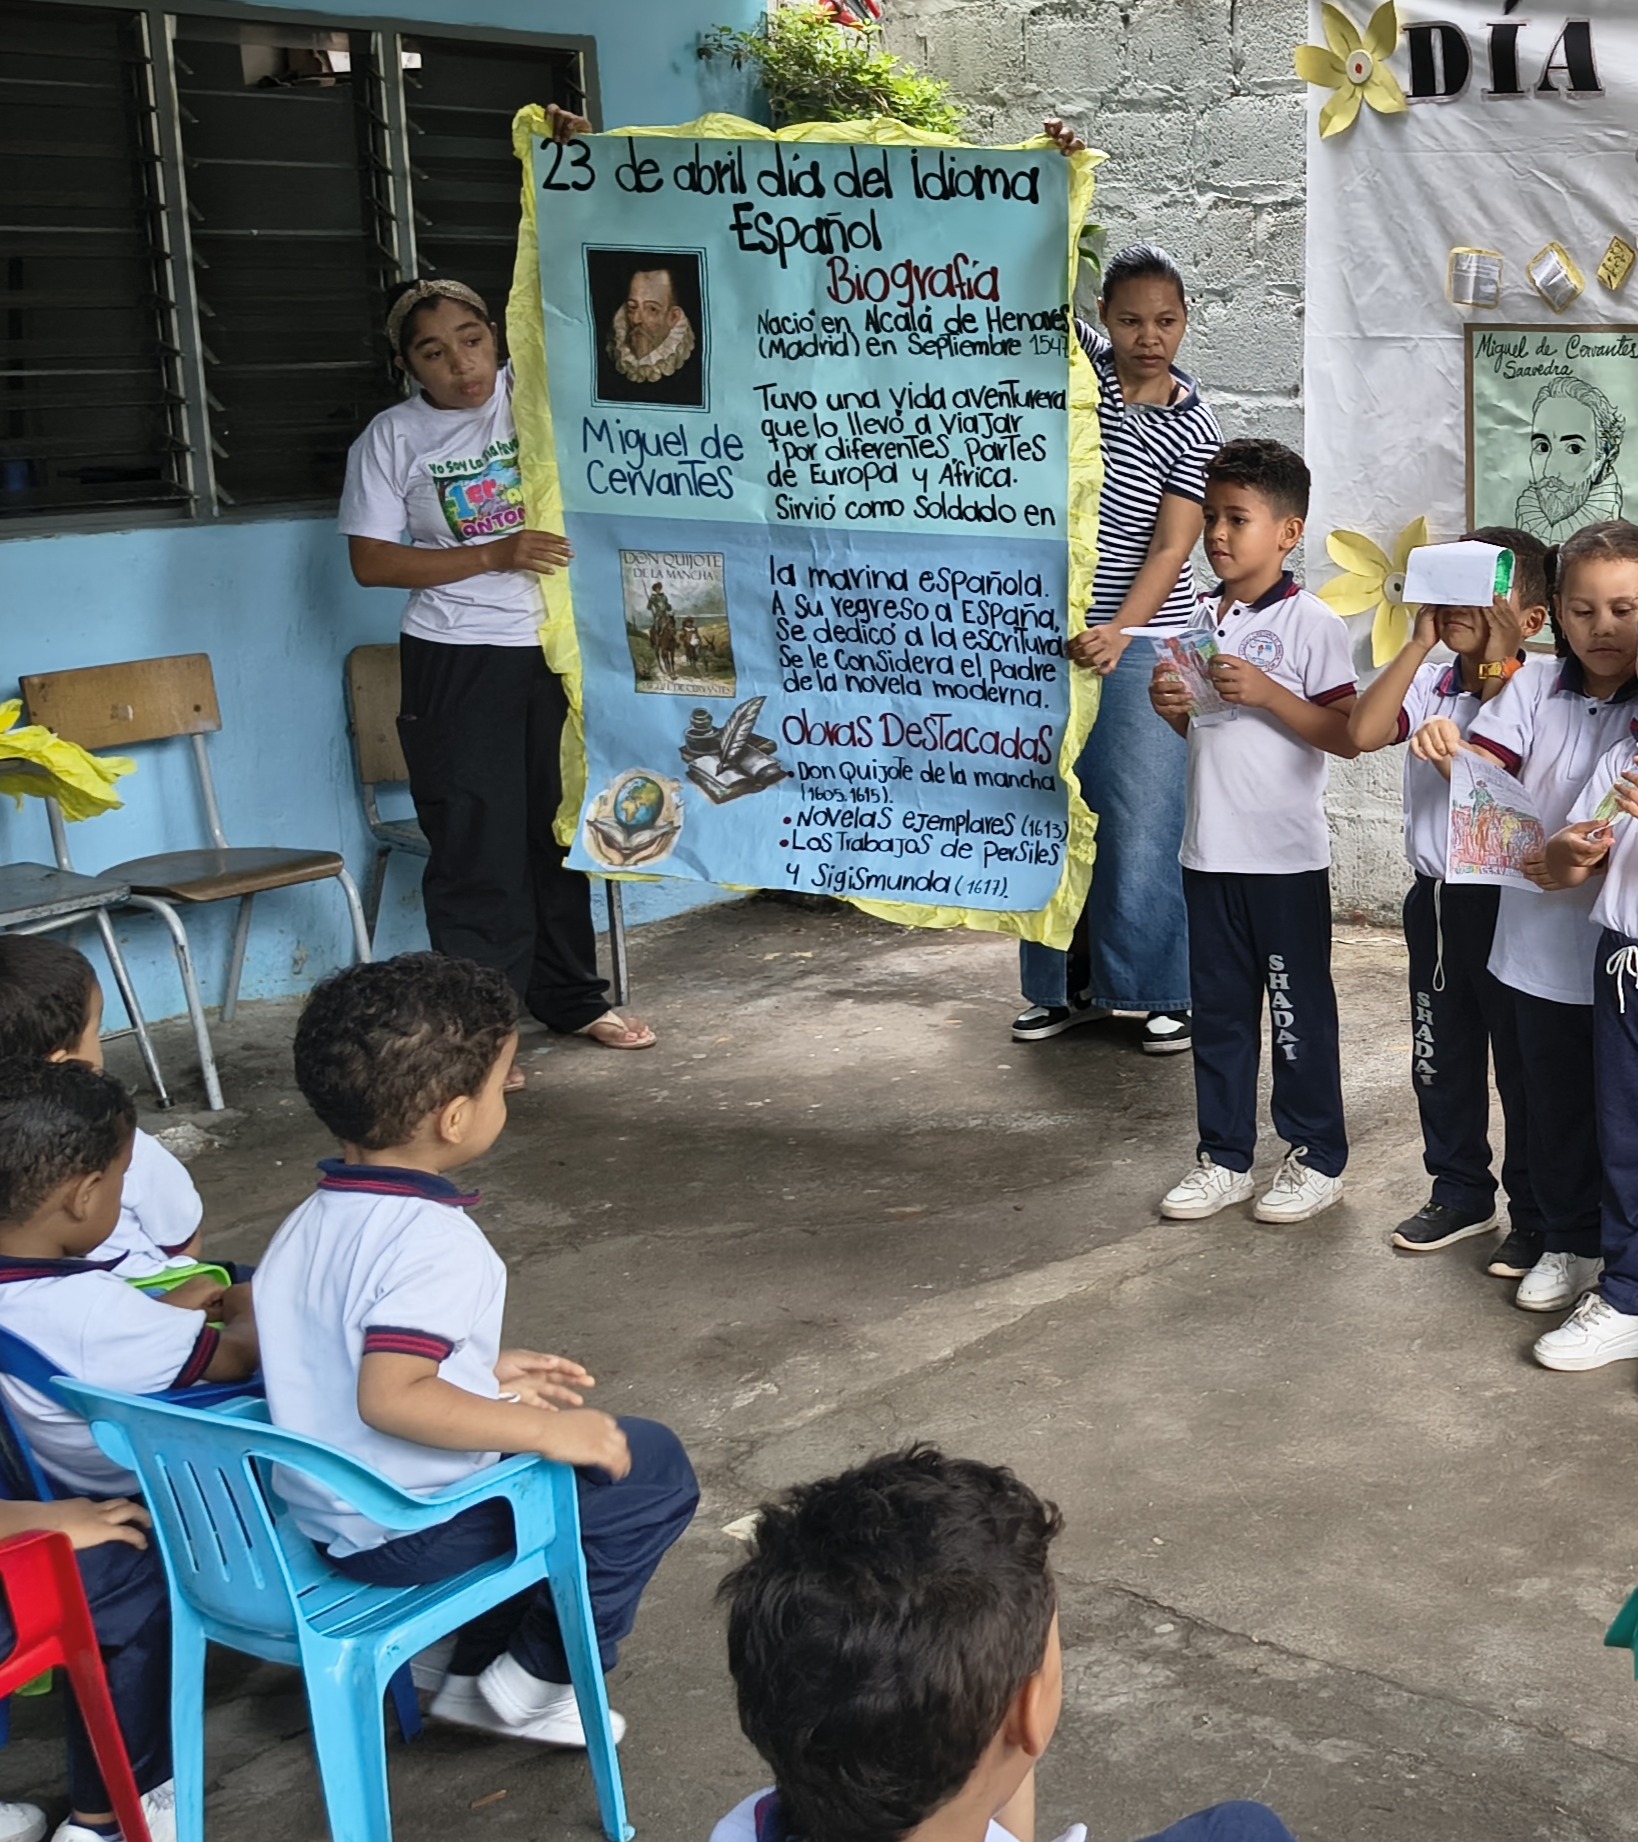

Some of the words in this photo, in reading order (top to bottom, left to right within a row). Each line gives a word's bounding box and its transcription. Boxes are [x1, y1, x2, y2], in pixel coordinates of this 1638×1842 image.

[1402, 4, 1605, 104] DÍA
[540, 137, 596, 191] 23
[614, 136, 664, 193] de
[673, 143, 747, 195] abril
[834, 146, 893, 198] del
[729, 201, 882, 269] Español
[826, 253, 1000, 308] Biografía
[757, 308, 816, 336] Nació
[821, 315, 851, 335] en
[865, 304, 934, 334] Alcalá
[944, 303, 979, 335] de
[759, 332, 860, 360] (Madrid)
[866, 337, 897, 356] en
[1475, 334, 1530, 373] Miguel
[1535, 335, 1558, 356] de
[1503, 359, 1574, 380] Saavedra
[753, 383, 818, 411] Tuvo
[826, 388, 880, 411] una
[582, 416, 688, 470] Miguel
[701, 423, 744, 461] de
[761, 418, 810, 445] que
[813, 414, 838, 438] lo
[914, 415, 933, 435] a
[767, 460, 798, 487] de
[912, 466, 928, 492] y
[775, 494, 836, 521] Sirvió
[845, 498, 905, 518] como
[1023, 504, 1056, 526] en
[624, 552, 659, 565] DON
[663, 554, 722, 568] QUIJOTE
[633, 568, 647, 578] DE
[651, 568, 663, 579] LA
[667, 570, 713, 581] MANCHA
[769, 555, 797, 587] la
[808, 565, 909, 592] marina
[771, 590, 786, 616] A
[831, 596, 929, 623] regreso
[935, 602, 953, 623] a
[776, 617, 807, 643] Se
[813, 618, 897, 645] dedicó
[905, 626, 924, 647] a
[930, 621, 957, 650] la
[779, 644, 804, 668] Se
[808, 645, 830, 669] le
[960, 653, 982, 677] el
[783, 669, 813, 693] de
[818, 669, 838, 692] la
[845, 673, 923, 696] novela
[782, 708, 874, 748] Obras
[797, 761, 836, 782] Don
[920, 760, 946, 784] de
[949, 761, 967, 786] la
[974, 768, 1057, 792] mancha
[797, 806, 894, 828] Novelas
[1021, 814, 1069, 843] (1613)
[792, 829, 833, 852] Los
[940, 838, 973, 859] de
[811, 862, 951, 893] Sigismunda
[1267, 953, 1299, 1061] SHADAI
[1413, 991, 1438, 1086] SHADAI
